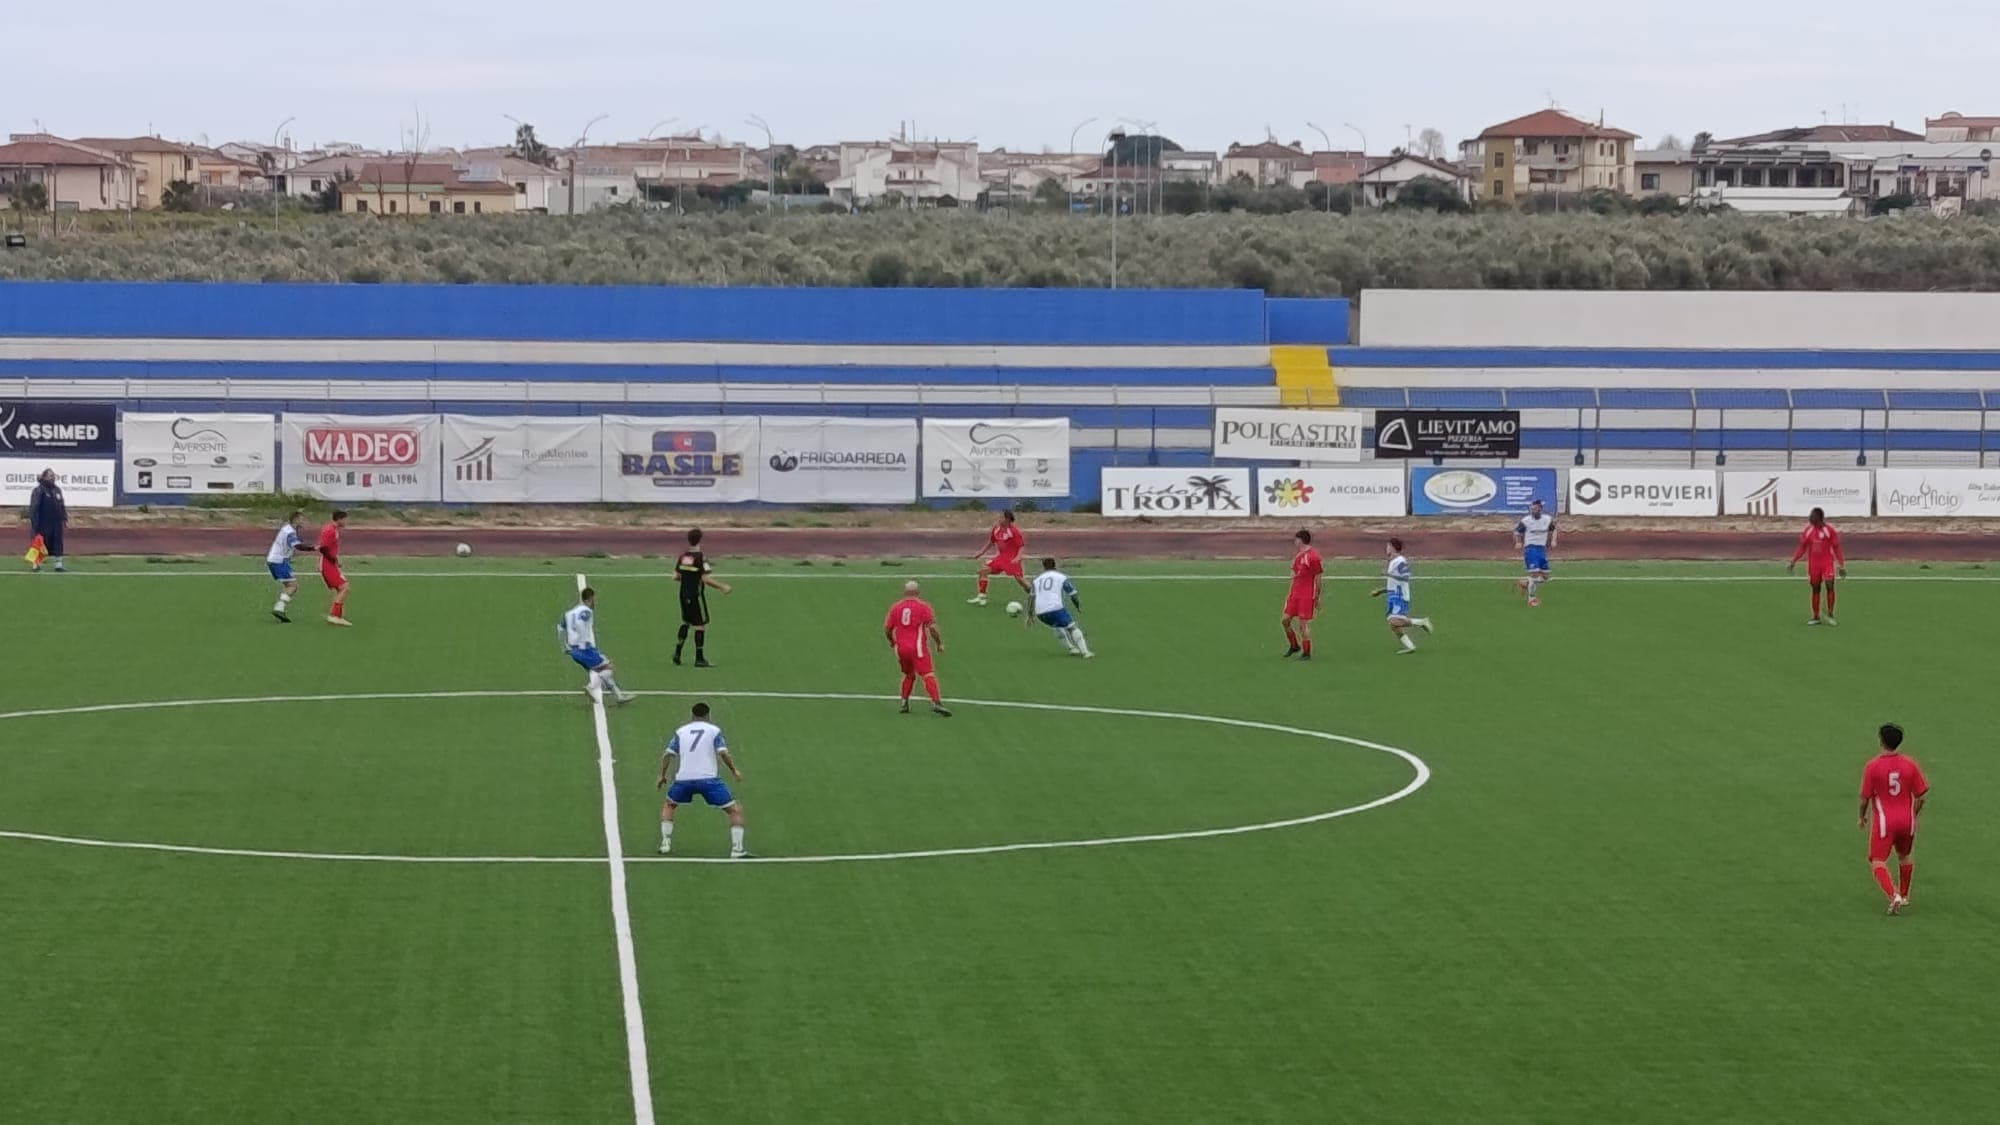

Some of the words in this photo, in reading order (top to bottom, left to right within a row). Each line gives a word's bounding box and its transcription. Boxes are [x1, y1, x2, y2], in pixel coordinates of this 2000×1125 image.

[15, 423, 99, 440] ASSIMED
[1221, 420, 1357, 445] POLICASTRI
[1417, 419, 1516, 434] LIEVIT'AMO
[172, 441, 227, 452] AVERSENTE
[308, 432, 415, 462] MADEO
[969, 445, 1022, 456] AVERSENTE
[621, 453, 741, 476] BASILE
[800, 451, 907, 465] FRIGOARREDA
[5, 473, 68, 484] GIUSPE
[71, 475, 109, 485] MIELE
[305, 472, 341, 484] FILIERA
[1607, 484, 1712, 500] SPROVIERI
[1039, 576, 1053, 592] 10
[689, 729, 705, 752] 7
[1888, 772, 1901, 796] 5
